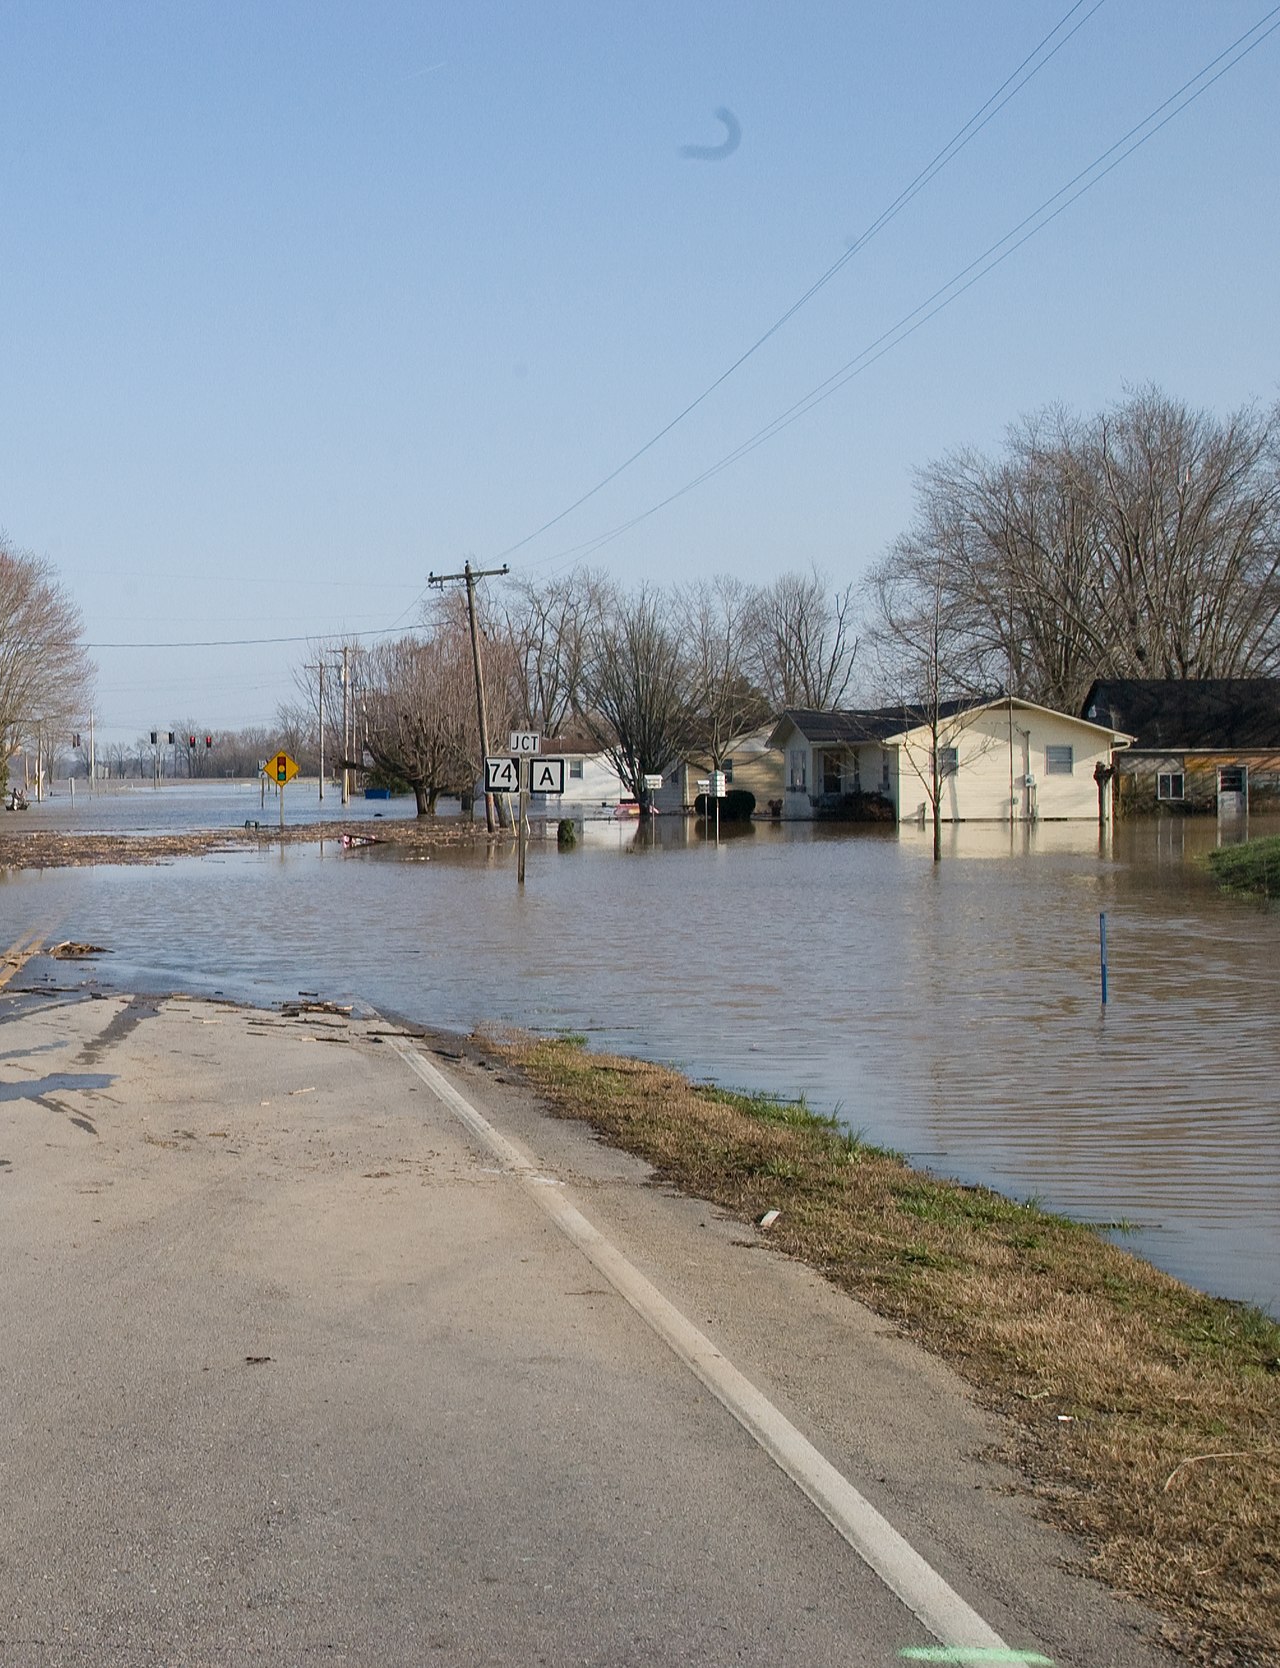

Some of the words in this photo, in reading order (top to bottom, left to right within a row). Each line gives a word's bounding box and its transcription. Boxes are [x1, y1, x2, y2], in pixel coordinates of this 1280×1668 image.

[511, 735, 538, 751] JCT
[489, 763, 512, 783] 74
[539, 766, 555, 786] A
